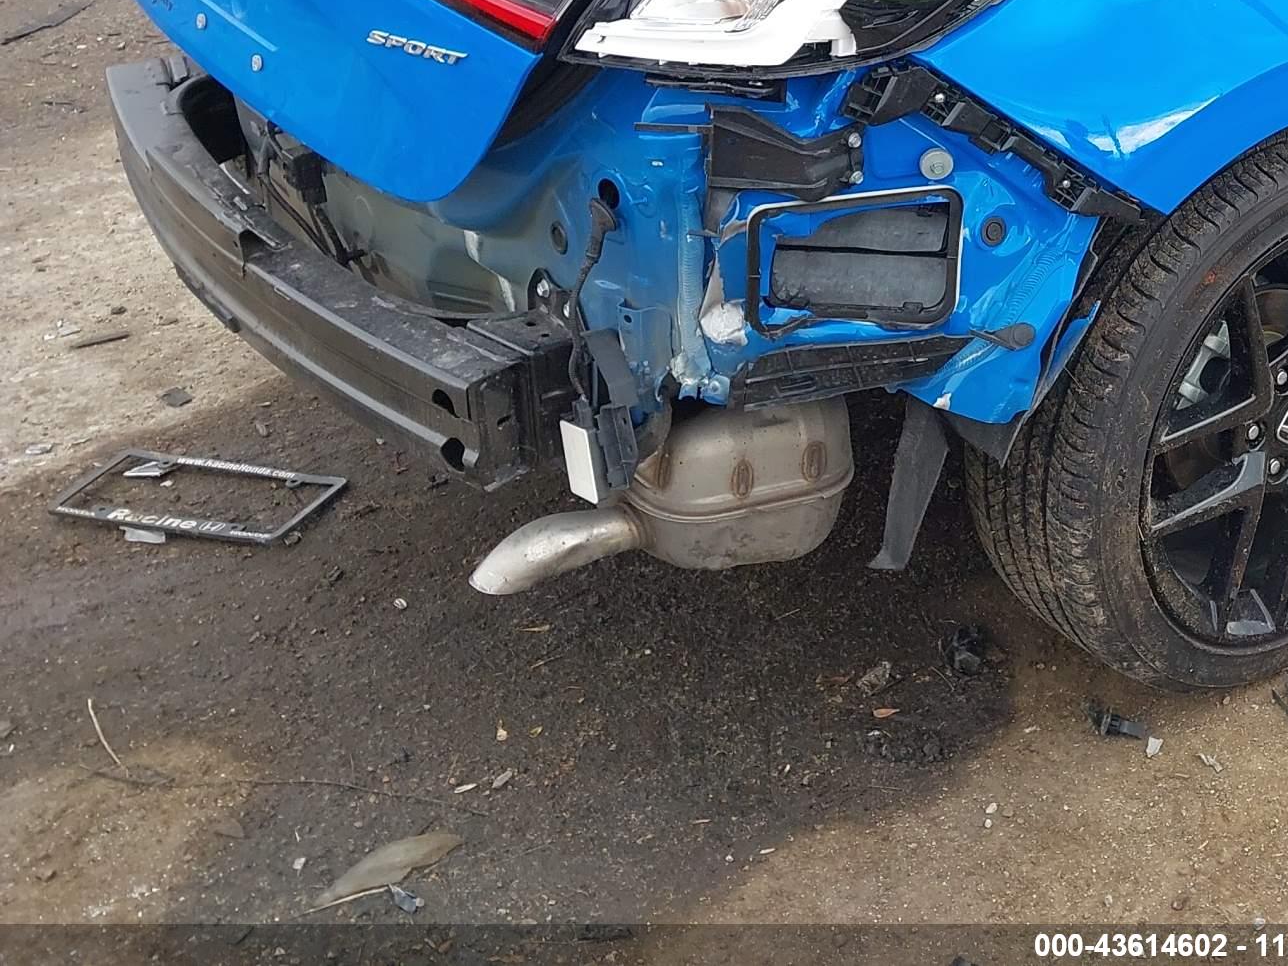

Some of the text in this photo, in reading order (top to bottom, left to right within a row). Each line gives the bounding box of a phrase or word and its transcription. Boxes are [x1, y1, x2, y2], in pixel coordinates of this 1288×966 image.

[366, 30, 469, 65] SPORT
[176, 457, 297, 479] www.RacineHonda.com
[106, 508, 198, 530] Racine
